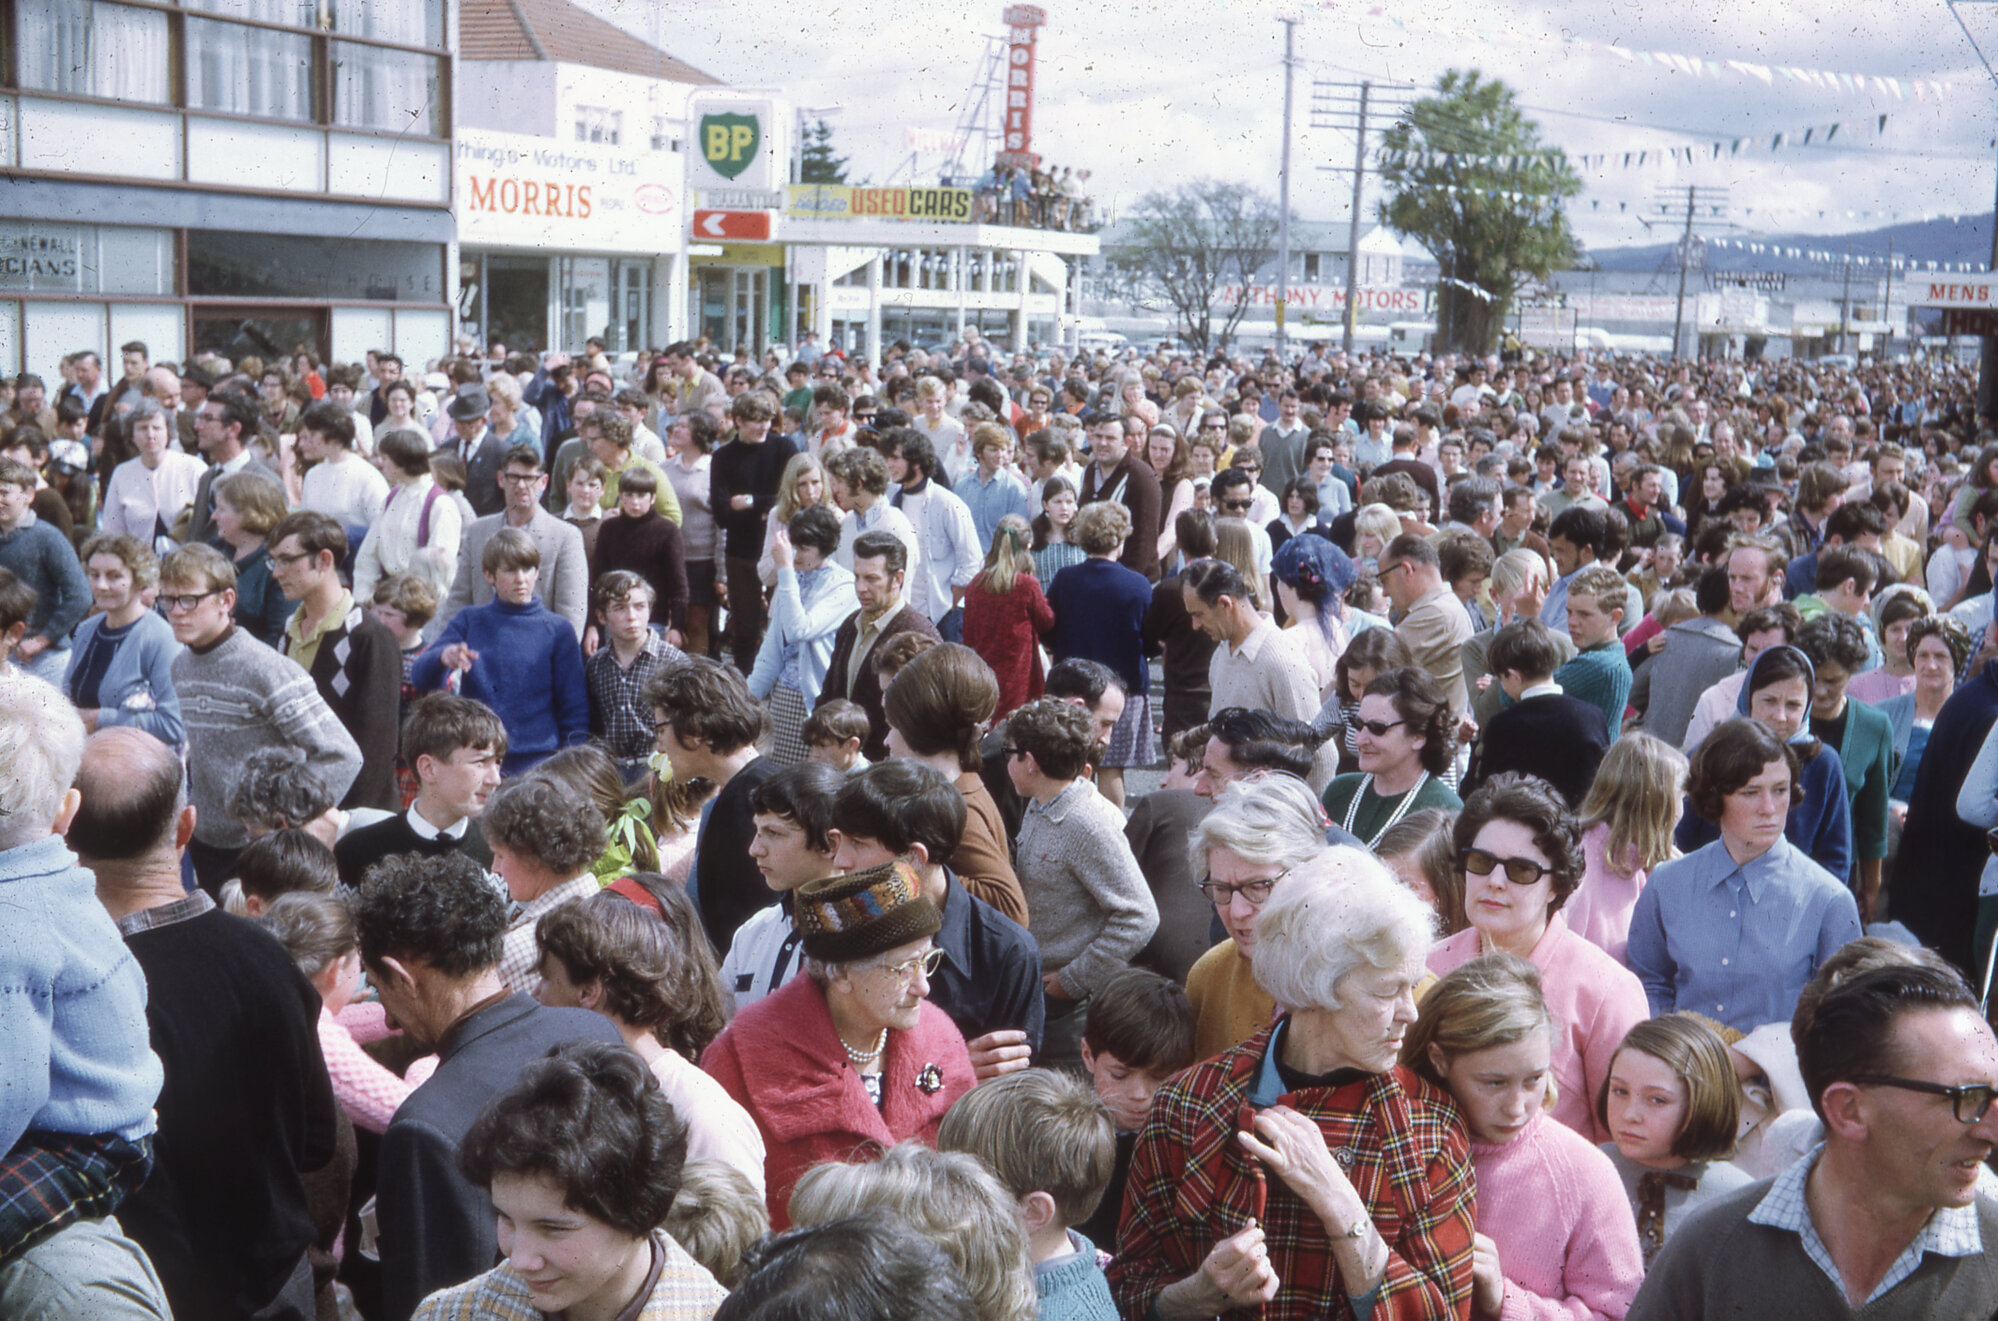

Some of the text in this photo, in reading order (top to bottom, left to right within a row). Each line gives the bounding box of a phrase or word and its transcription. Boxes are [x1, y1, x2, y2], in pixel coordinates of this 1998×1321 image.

[707, 124, 753, 161] BP
[534, 149, 597, 172] Motors
[469, 175, 592, 219] MORRIS
[852, 189, 905, 215] USED
[910, 190, 969, 217] CARS
[1929, 283, 1990, 301] MENS
